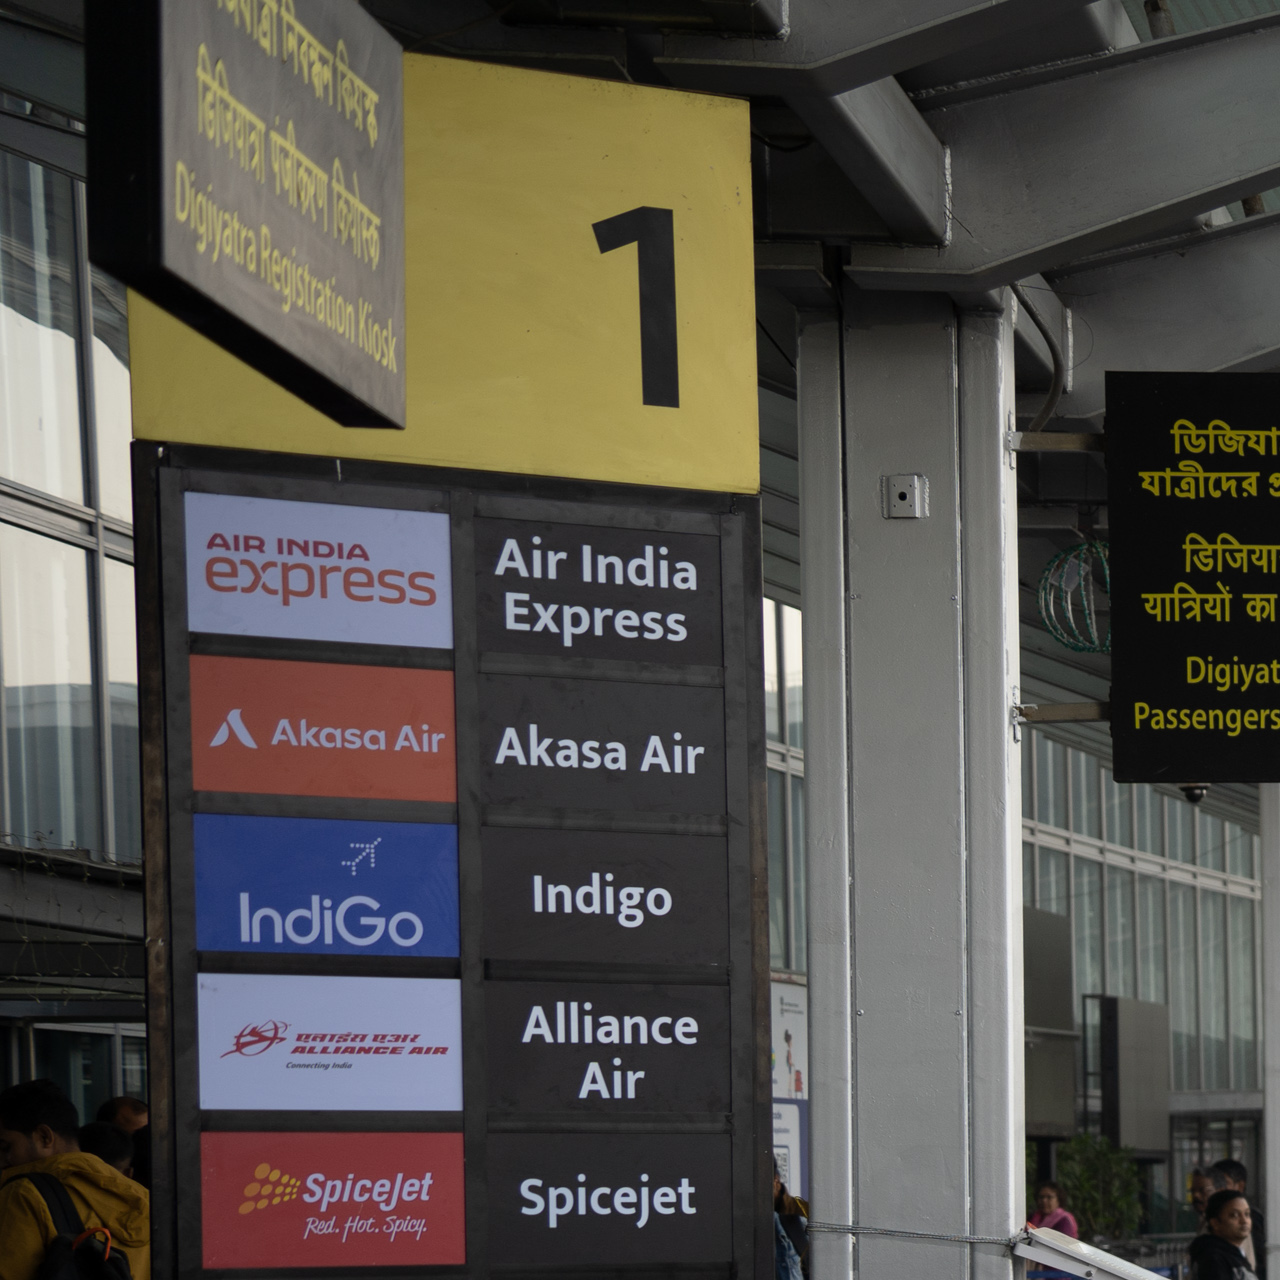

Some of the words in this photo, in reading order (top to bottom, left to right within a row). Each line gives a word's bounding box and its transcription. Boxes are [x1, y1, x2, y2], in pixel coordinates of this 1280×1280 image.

[196, 43, 266, 184] डिजियात्रा
[270, 115, 328, 233] पंजीकरण
[175, 160, 257, 274] Digiyatra
[260, 223, 355, 343] Registration
[358, 298, 397, 374] Kiosk
[592, 206, 680, 408] 1
[1139, 460, 1260, 499] যাত্রীদের
[206, 532, 267, 555] AIR
[276, 537, 370, 561] INDIA
[494, 535, 568, 580] Air
[582, 544, 698, 591] India
[205, 556, 437, 607] express
[1141, 581, 1232, 622] यात्रियों
[1243, 593, 1277, 622] का
[505, 591, 688, 647] Express
[270, 718, 386, 751] Akasa
[394, 723, 446, 753] Air
[494, 723, 627, 771] Akasa
[640, 731, 705, 774] Air
[239, 892, 424, 947] IndiGo
[532, 872, 673, 928] Indigo
[521, 1002, 699, 1046] Alliance
[285, 1062, 330, 1070] Connecting
[290, 1046, 405, 1055] ALLIANCE
[408, 1046, 449, 1055] AIR
[579, 1060, 645, 1099] Air
[303, 1172, 433, 1212] SpiceJet
[520, 1173, 697, 1229] Spicejet
[304, 1216, 339, 1240] Red.
[342, 1216, 379, 1243] Hot.
[383, 1215, 427, 1242] Spicy.
